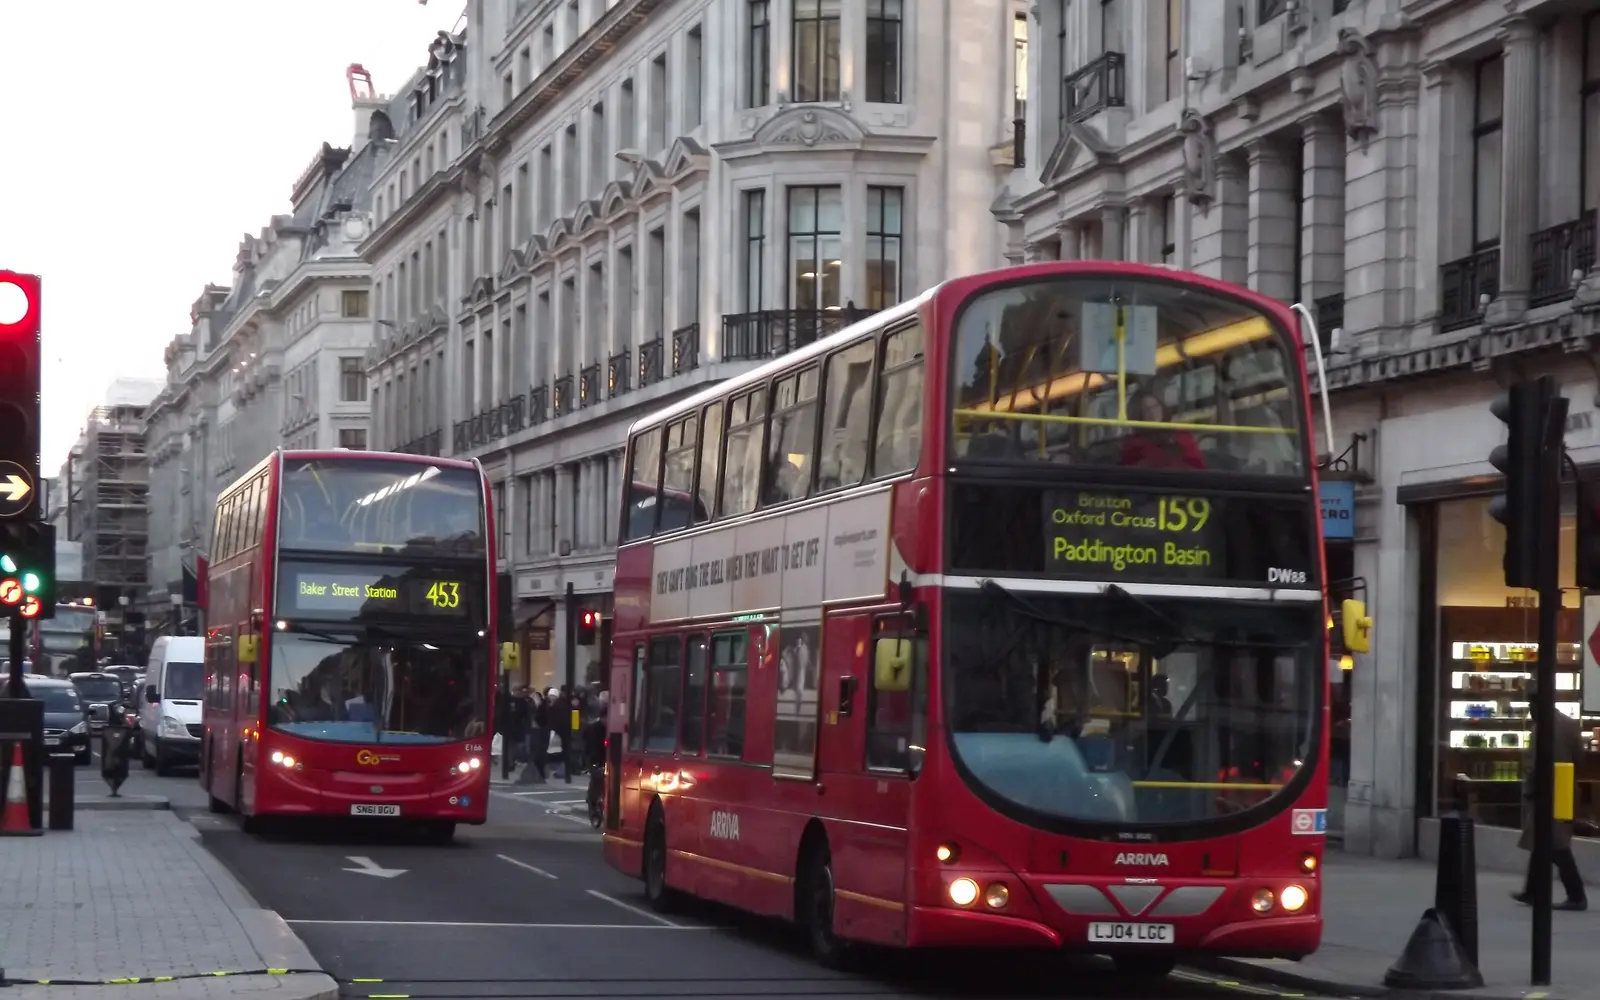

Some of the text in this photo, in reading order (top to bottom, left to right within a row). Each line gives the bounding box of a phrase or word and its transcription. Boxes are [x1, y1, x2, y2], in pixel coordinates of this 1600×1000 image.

[1078, 493, 1131, 509] Brixton
[1052, 509, 1156, 528] Oxford Circus
[1158, 497, 1209, 532] 159
[699, 562, 710, 587] THE
[710, 559, 724, 585] BELL
[744, 550, 760, 579] THEY
[790, 541, 805, 570] GET
[806, 537, 820, 568] OFF
[1053, 537, 1211, 571] Paddington Basin
[1268, 567, 1306, 583] DW88
[300, 582, 397, 599] Baker Street Station
[426, 581, 460, 608] 453
[356, 806, 376, 814] SN61
[710, 811, 740, 841] ARRIVA
[1114, 852, 1169, 866] ARRIVA
[1095, 923, 1166, 940] LJ04 LGC
